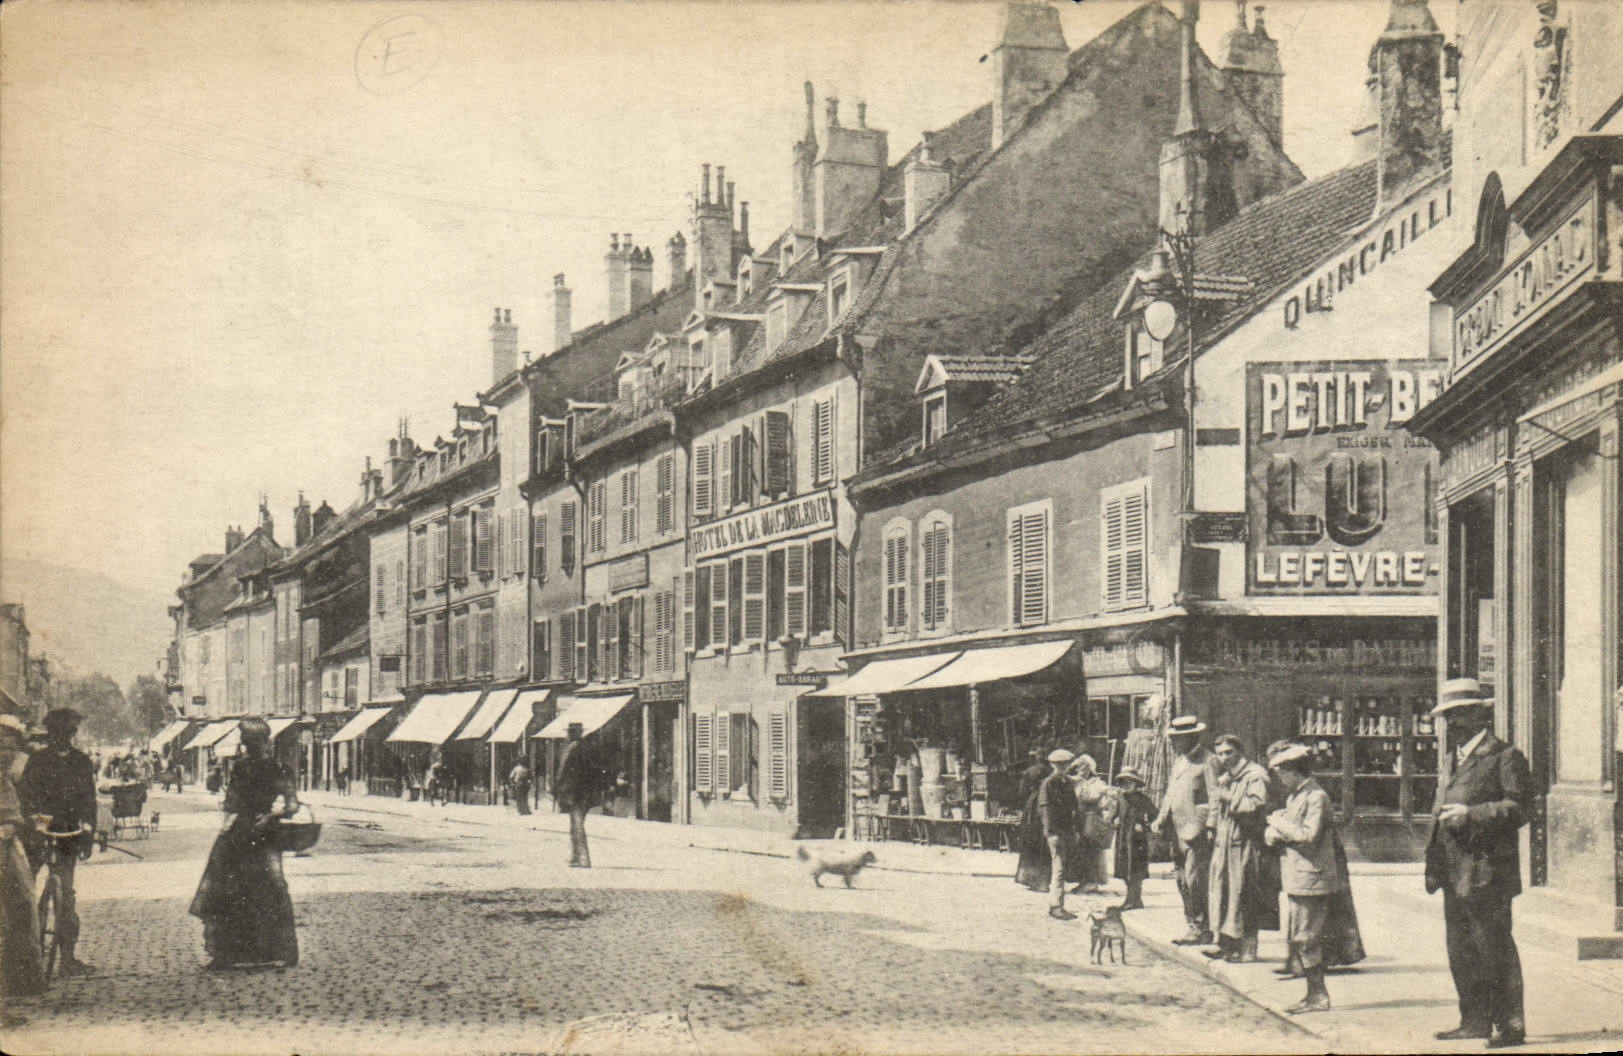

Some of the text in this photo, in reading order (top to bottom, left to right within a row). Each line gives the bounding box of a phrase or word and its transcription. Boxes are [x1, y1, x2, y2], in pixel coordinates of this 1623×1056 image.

[692, 524, 728, 554] HOTEL
[728, 519, 744, 545] DE
[745, 514, 760, 540] LA
